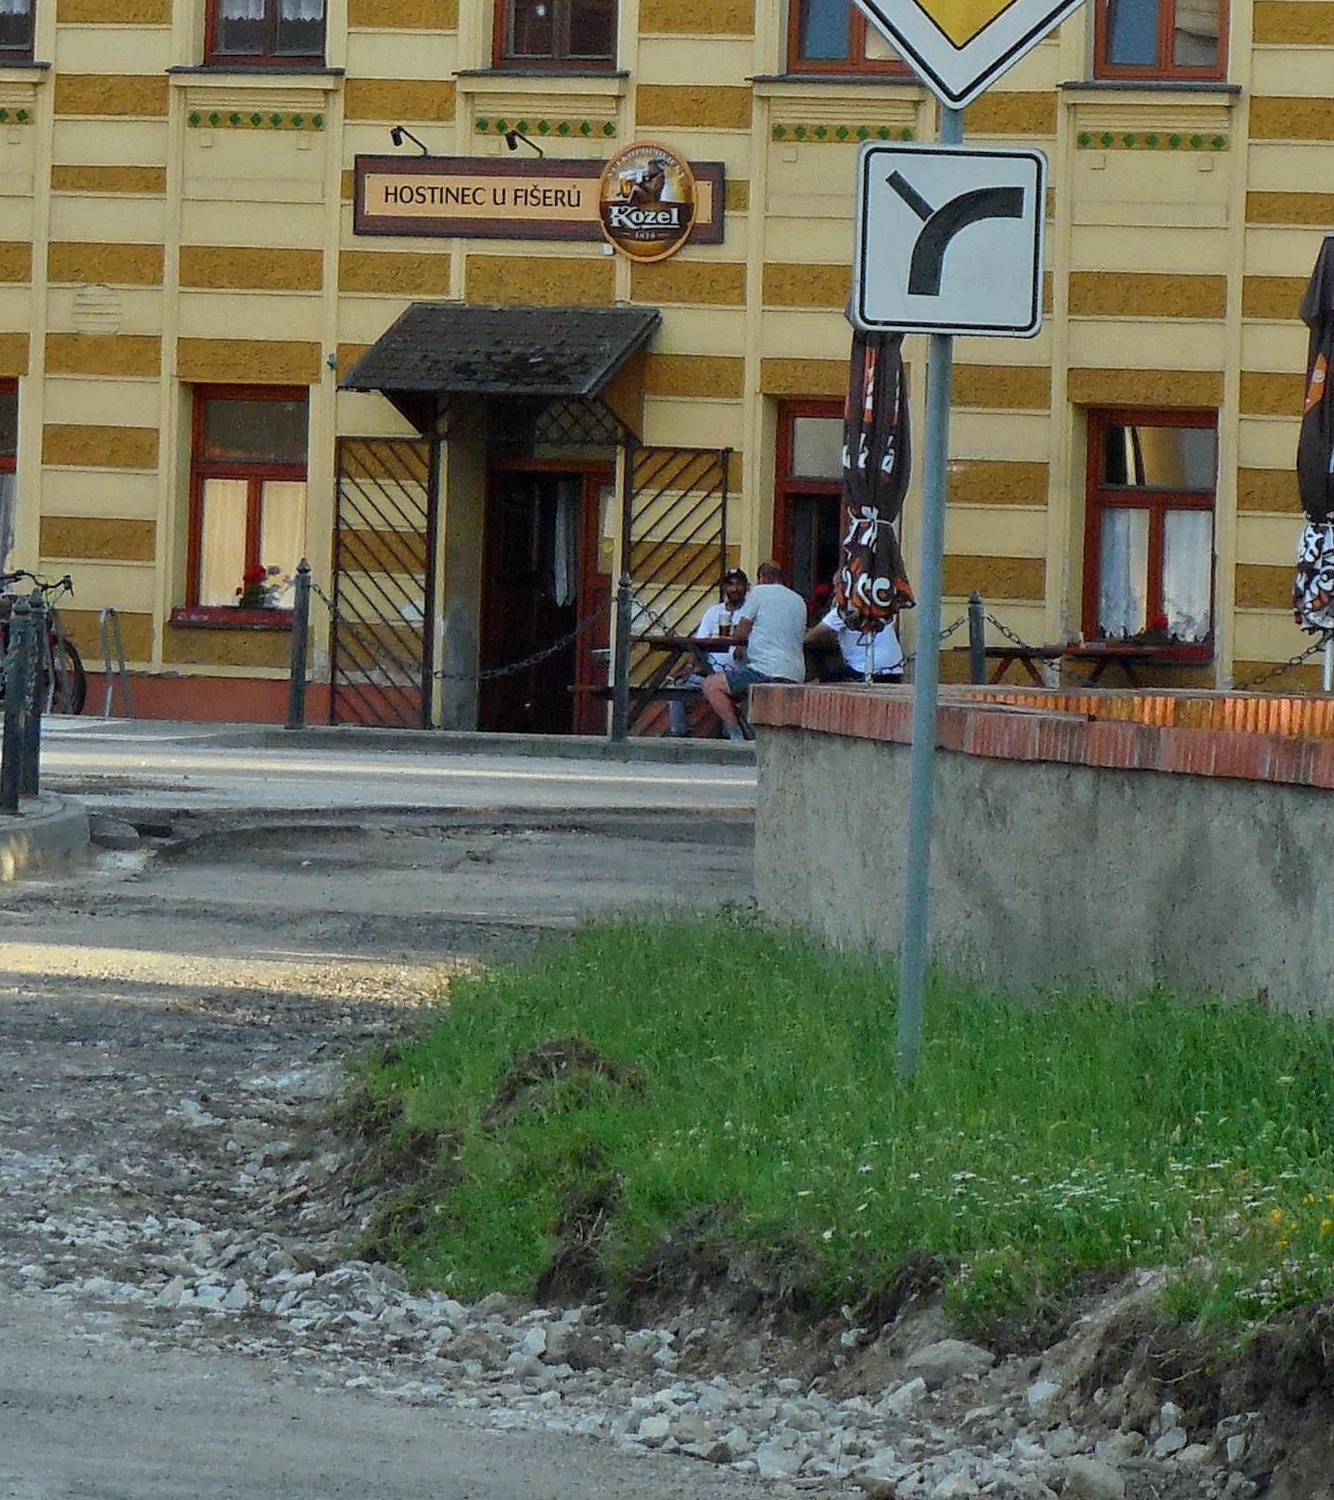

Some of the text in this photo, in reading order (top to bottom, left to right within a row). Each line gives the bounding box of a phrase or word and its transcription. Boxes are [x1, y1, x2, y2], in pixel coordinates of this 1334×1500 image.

[384, 183, 581, 208] HOSTINEC U FIŠERŮ
[608, 205, 681, 229] Kozel
